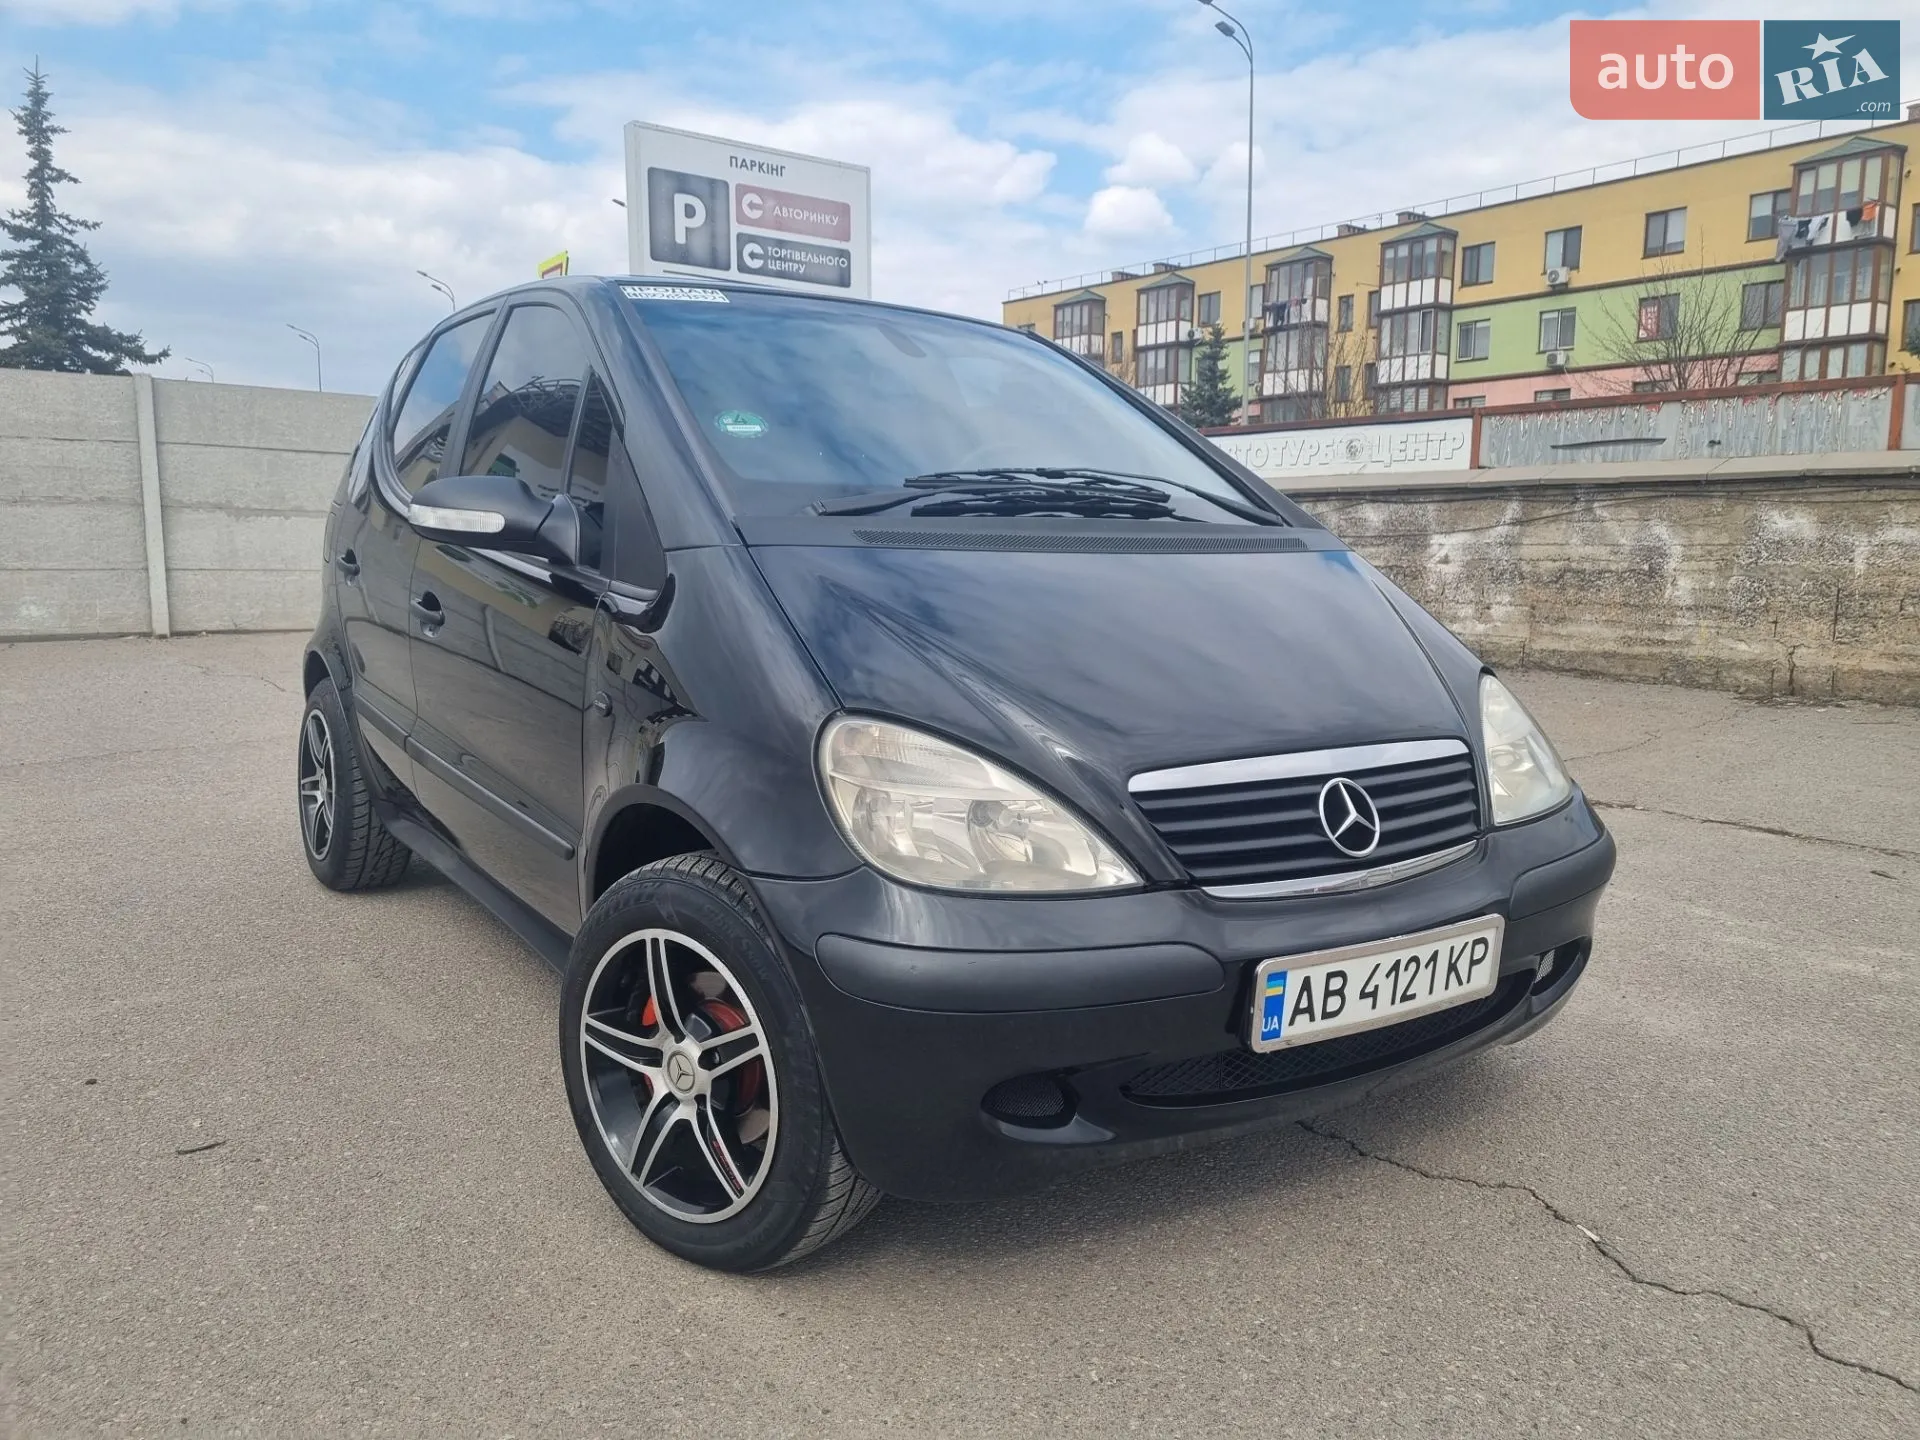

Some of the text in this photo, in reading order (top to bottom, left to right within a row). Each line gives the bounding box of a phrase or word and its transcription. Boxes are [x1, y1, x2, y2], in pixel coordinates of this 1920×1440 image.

[729, 155, 786, 177] ПАРКІНГ
[674, 192, 706, 244] P
[773, 205, 839, 226] АВТОРИНКУ
[767, 246, 848, 268] ТОРГІВЕЛЬНОГО
[768, 260, 806, 274] ЦЕНТРУ
[1370, 431, 1465, 468] ЦЕНТР
[1288, 936, 1490, 1027] AB 4121 KP
[1262, 1016, 1279, 1032] UA
